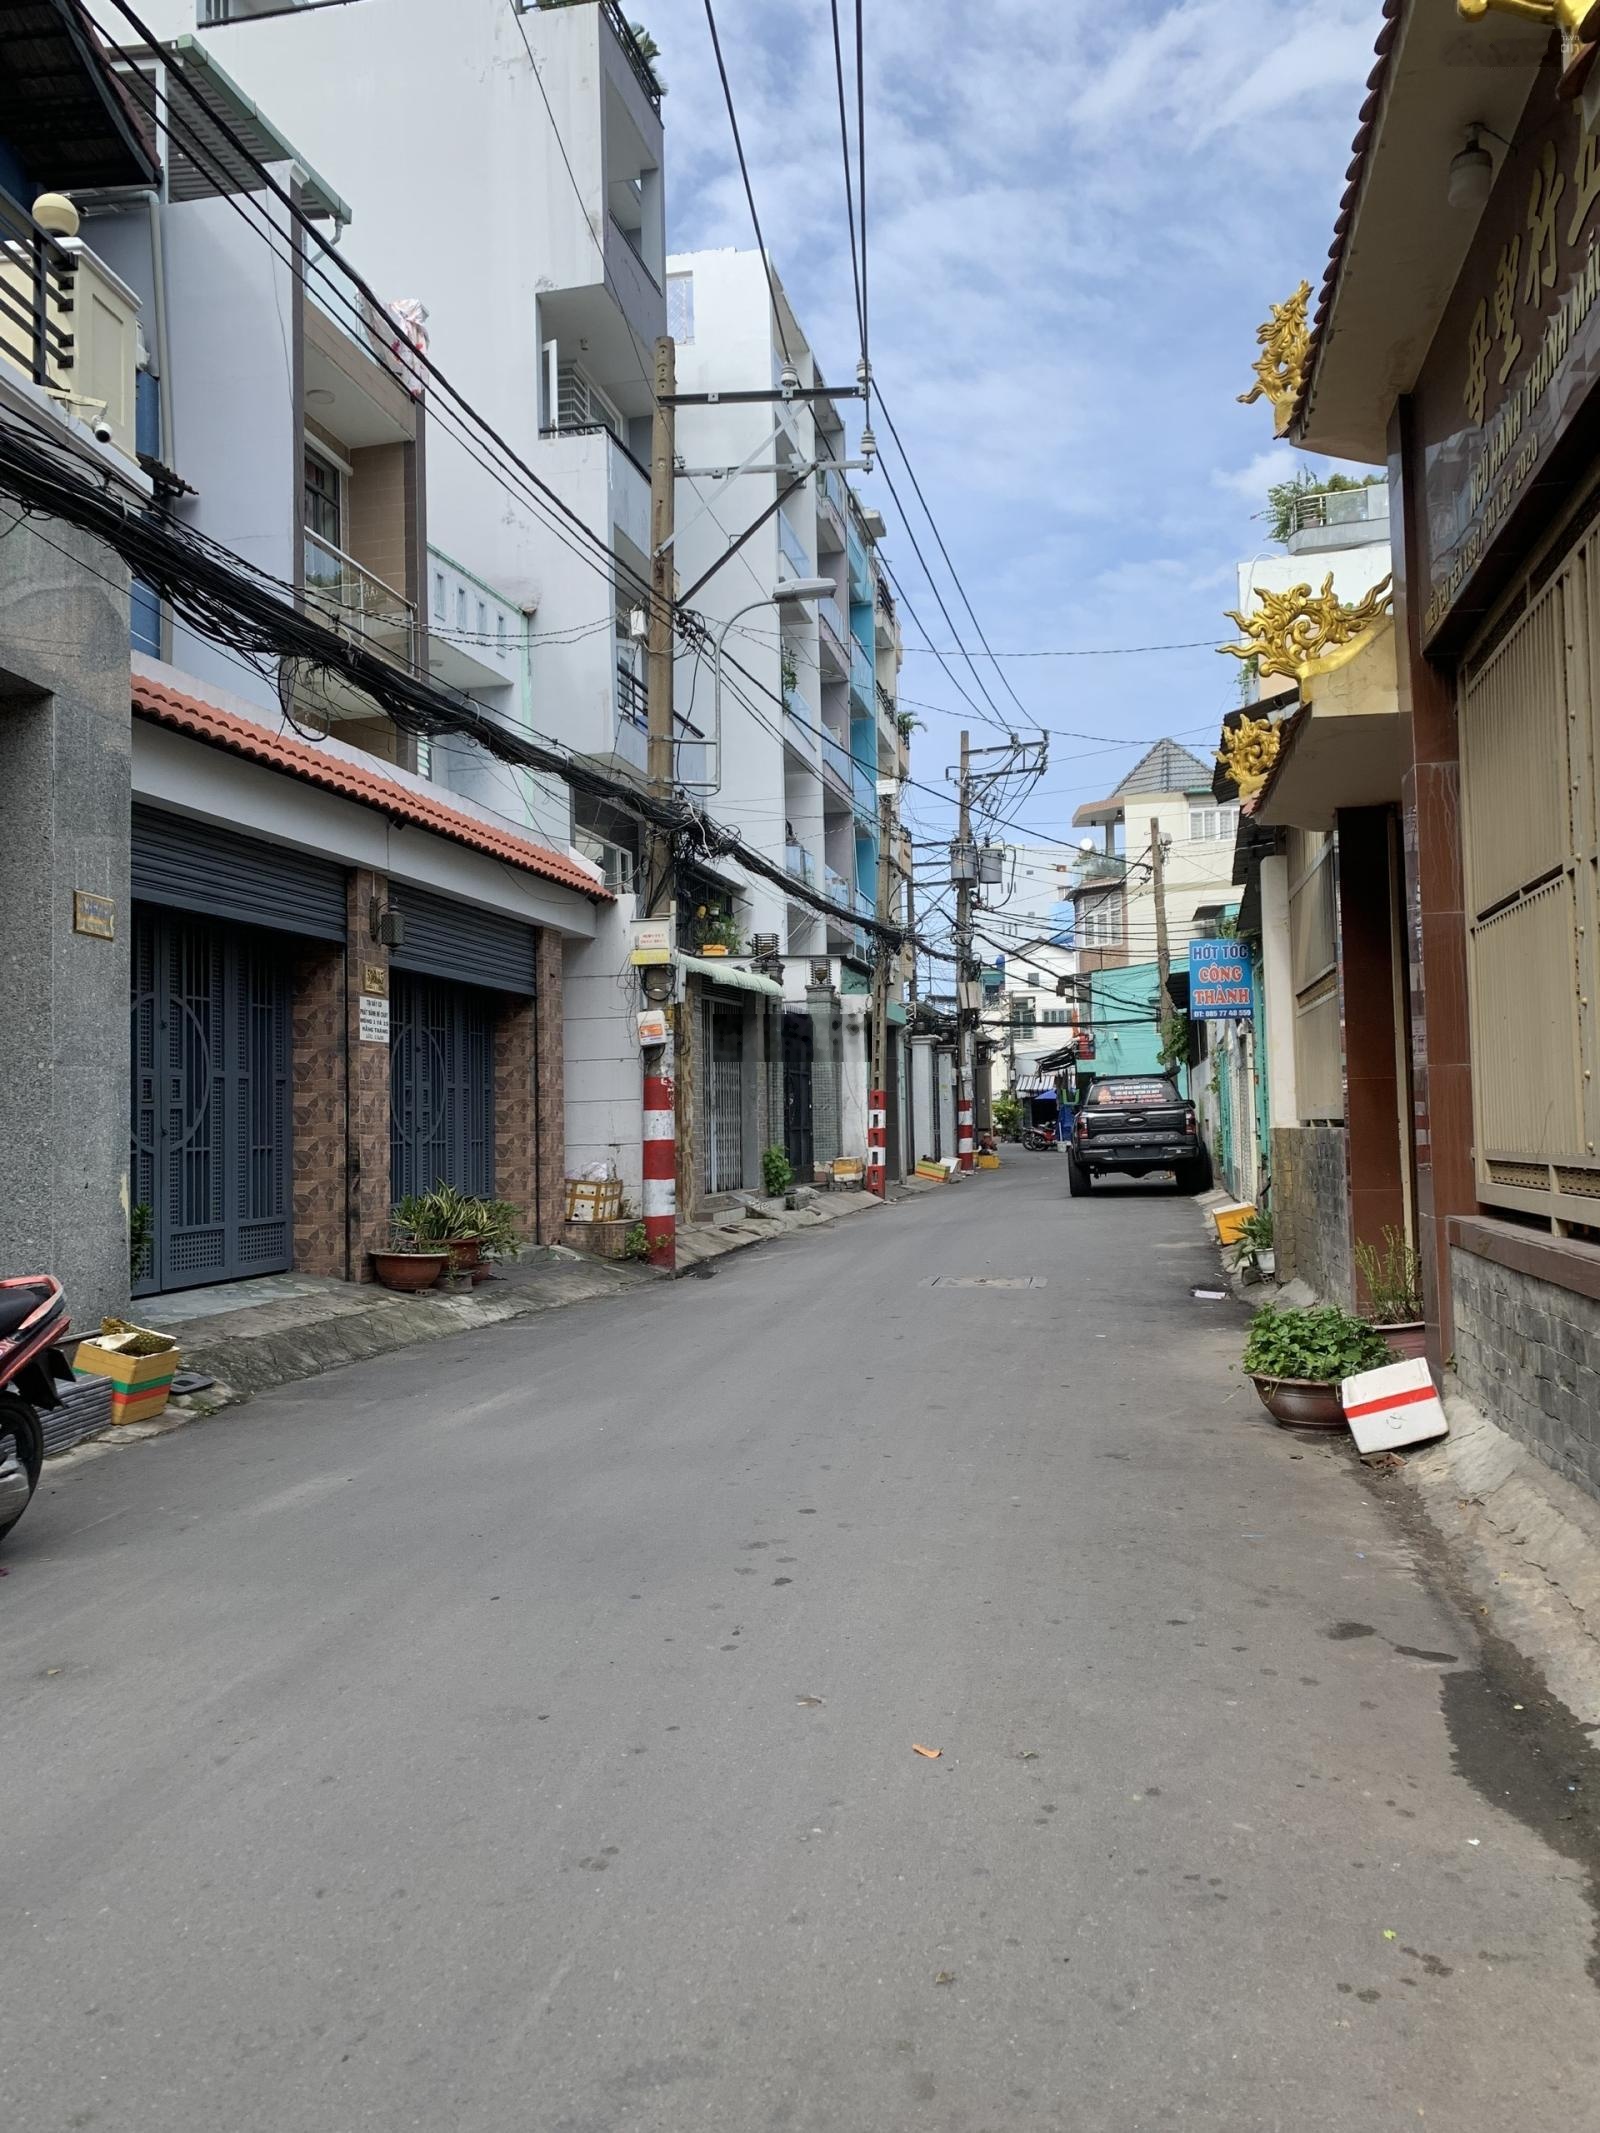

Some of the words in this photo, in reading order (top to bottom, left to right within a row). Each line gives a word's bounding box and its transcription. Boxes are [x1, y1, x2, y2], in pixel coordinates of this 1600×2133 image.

[1525, 302, 1569, 417] THÁNH
[1514, 431, 1540, 491] 2020
[1193, 943, 1219, 960] HỚT
[1222, 942, 1249, 959] TÓC
[1199, 962, 1243, 984] CÔNG
[1193, 984, 1250, 1006] THÀNH
[1097, 1134, 1179, 1143] RANGER
